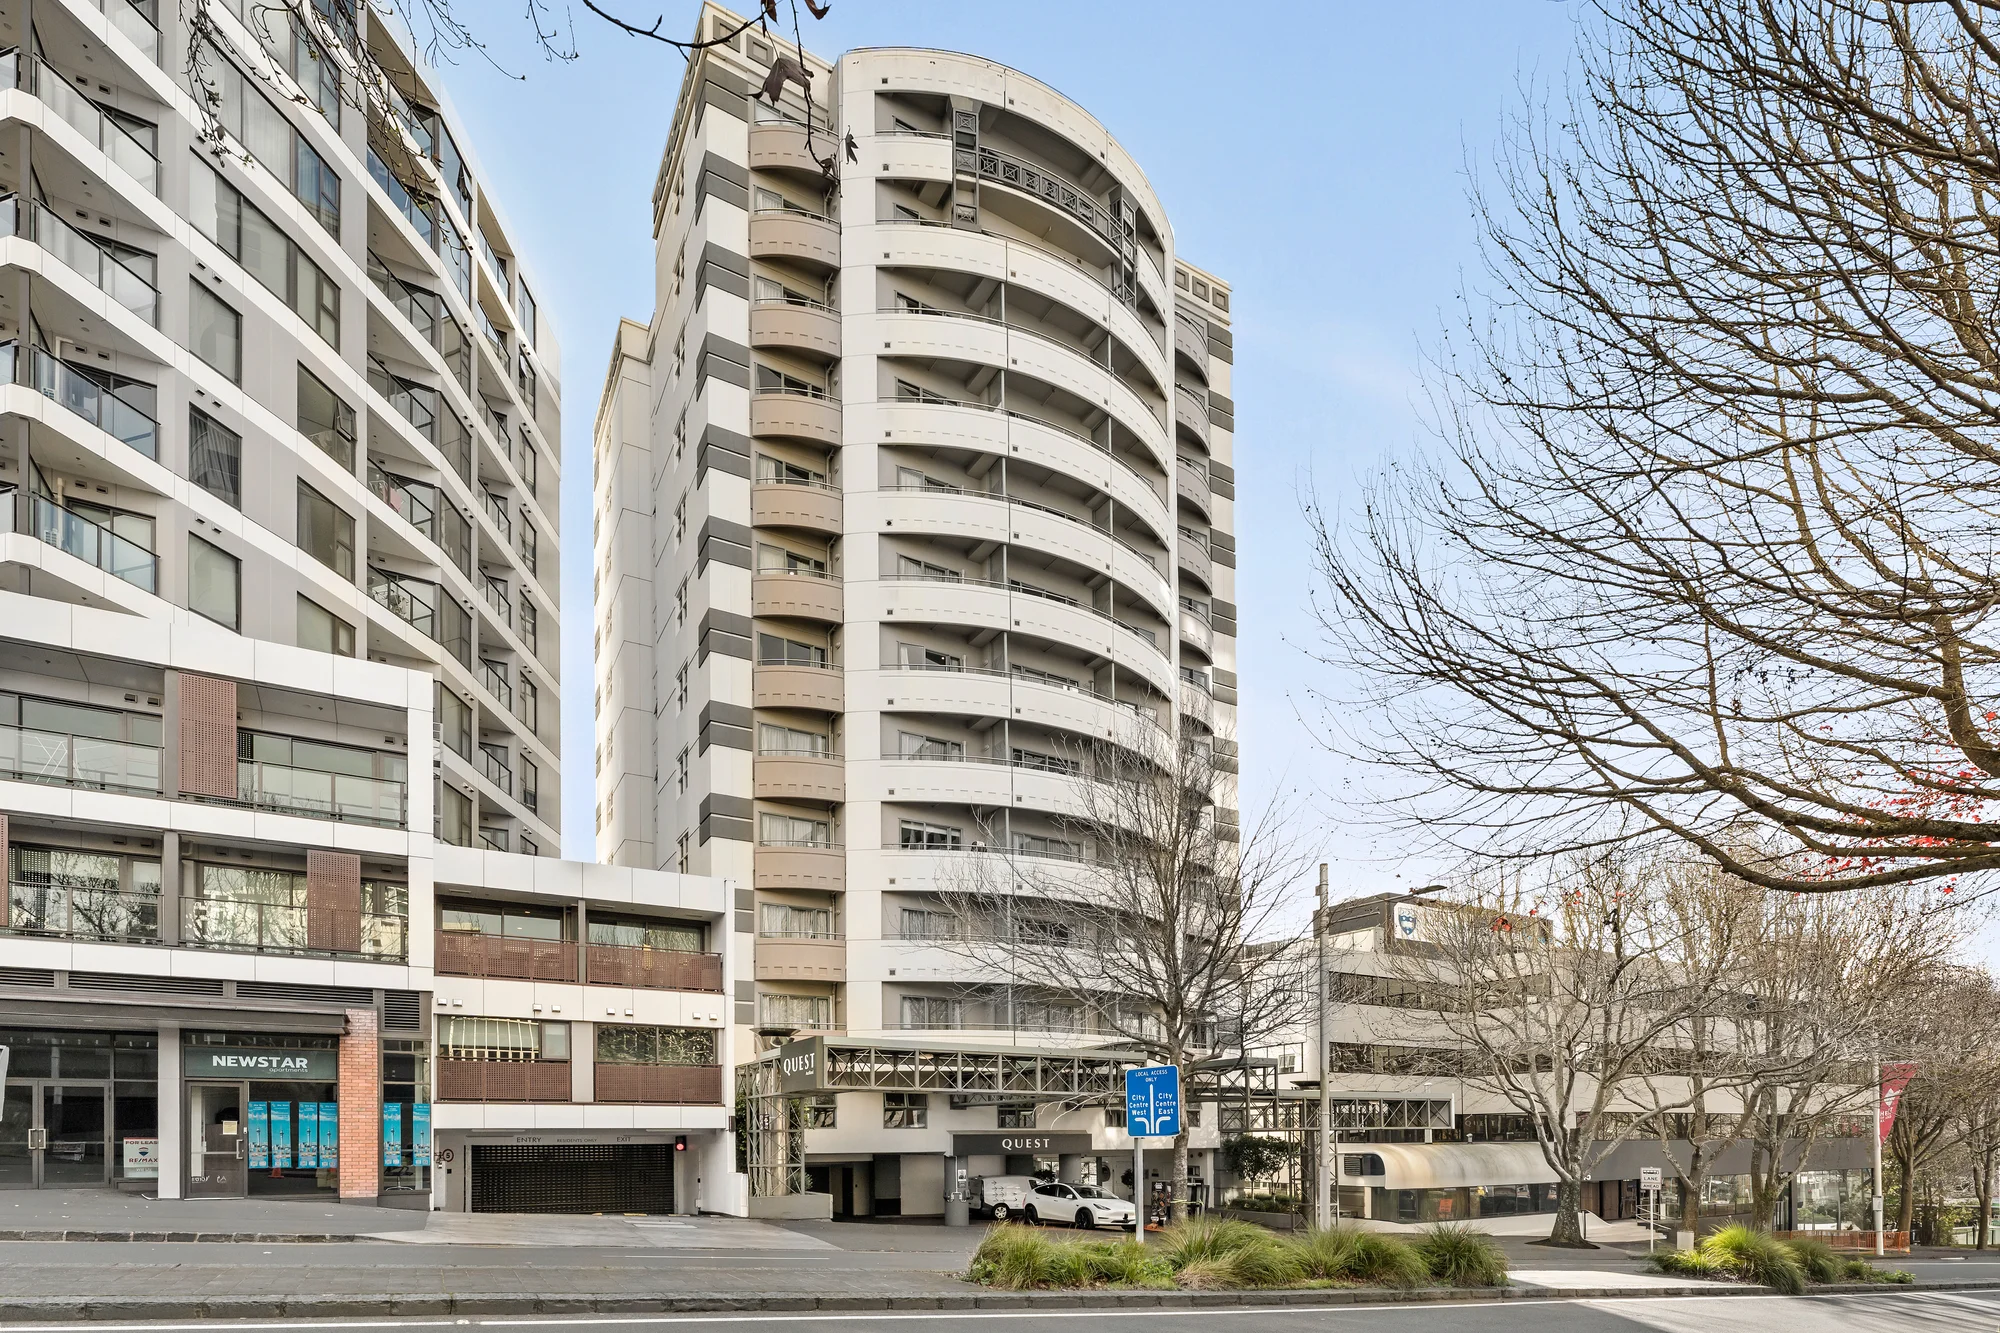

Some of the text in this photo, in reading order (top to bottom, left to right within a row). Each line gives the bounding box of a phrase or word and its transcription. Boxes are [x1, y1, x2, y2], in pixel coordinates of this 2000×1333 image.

[212, 1055, 308, 1068] NEWSTAR
[784, 1052, 815, 1076] QUEST
[1001, 1138, 1050, 1151] QUEST
